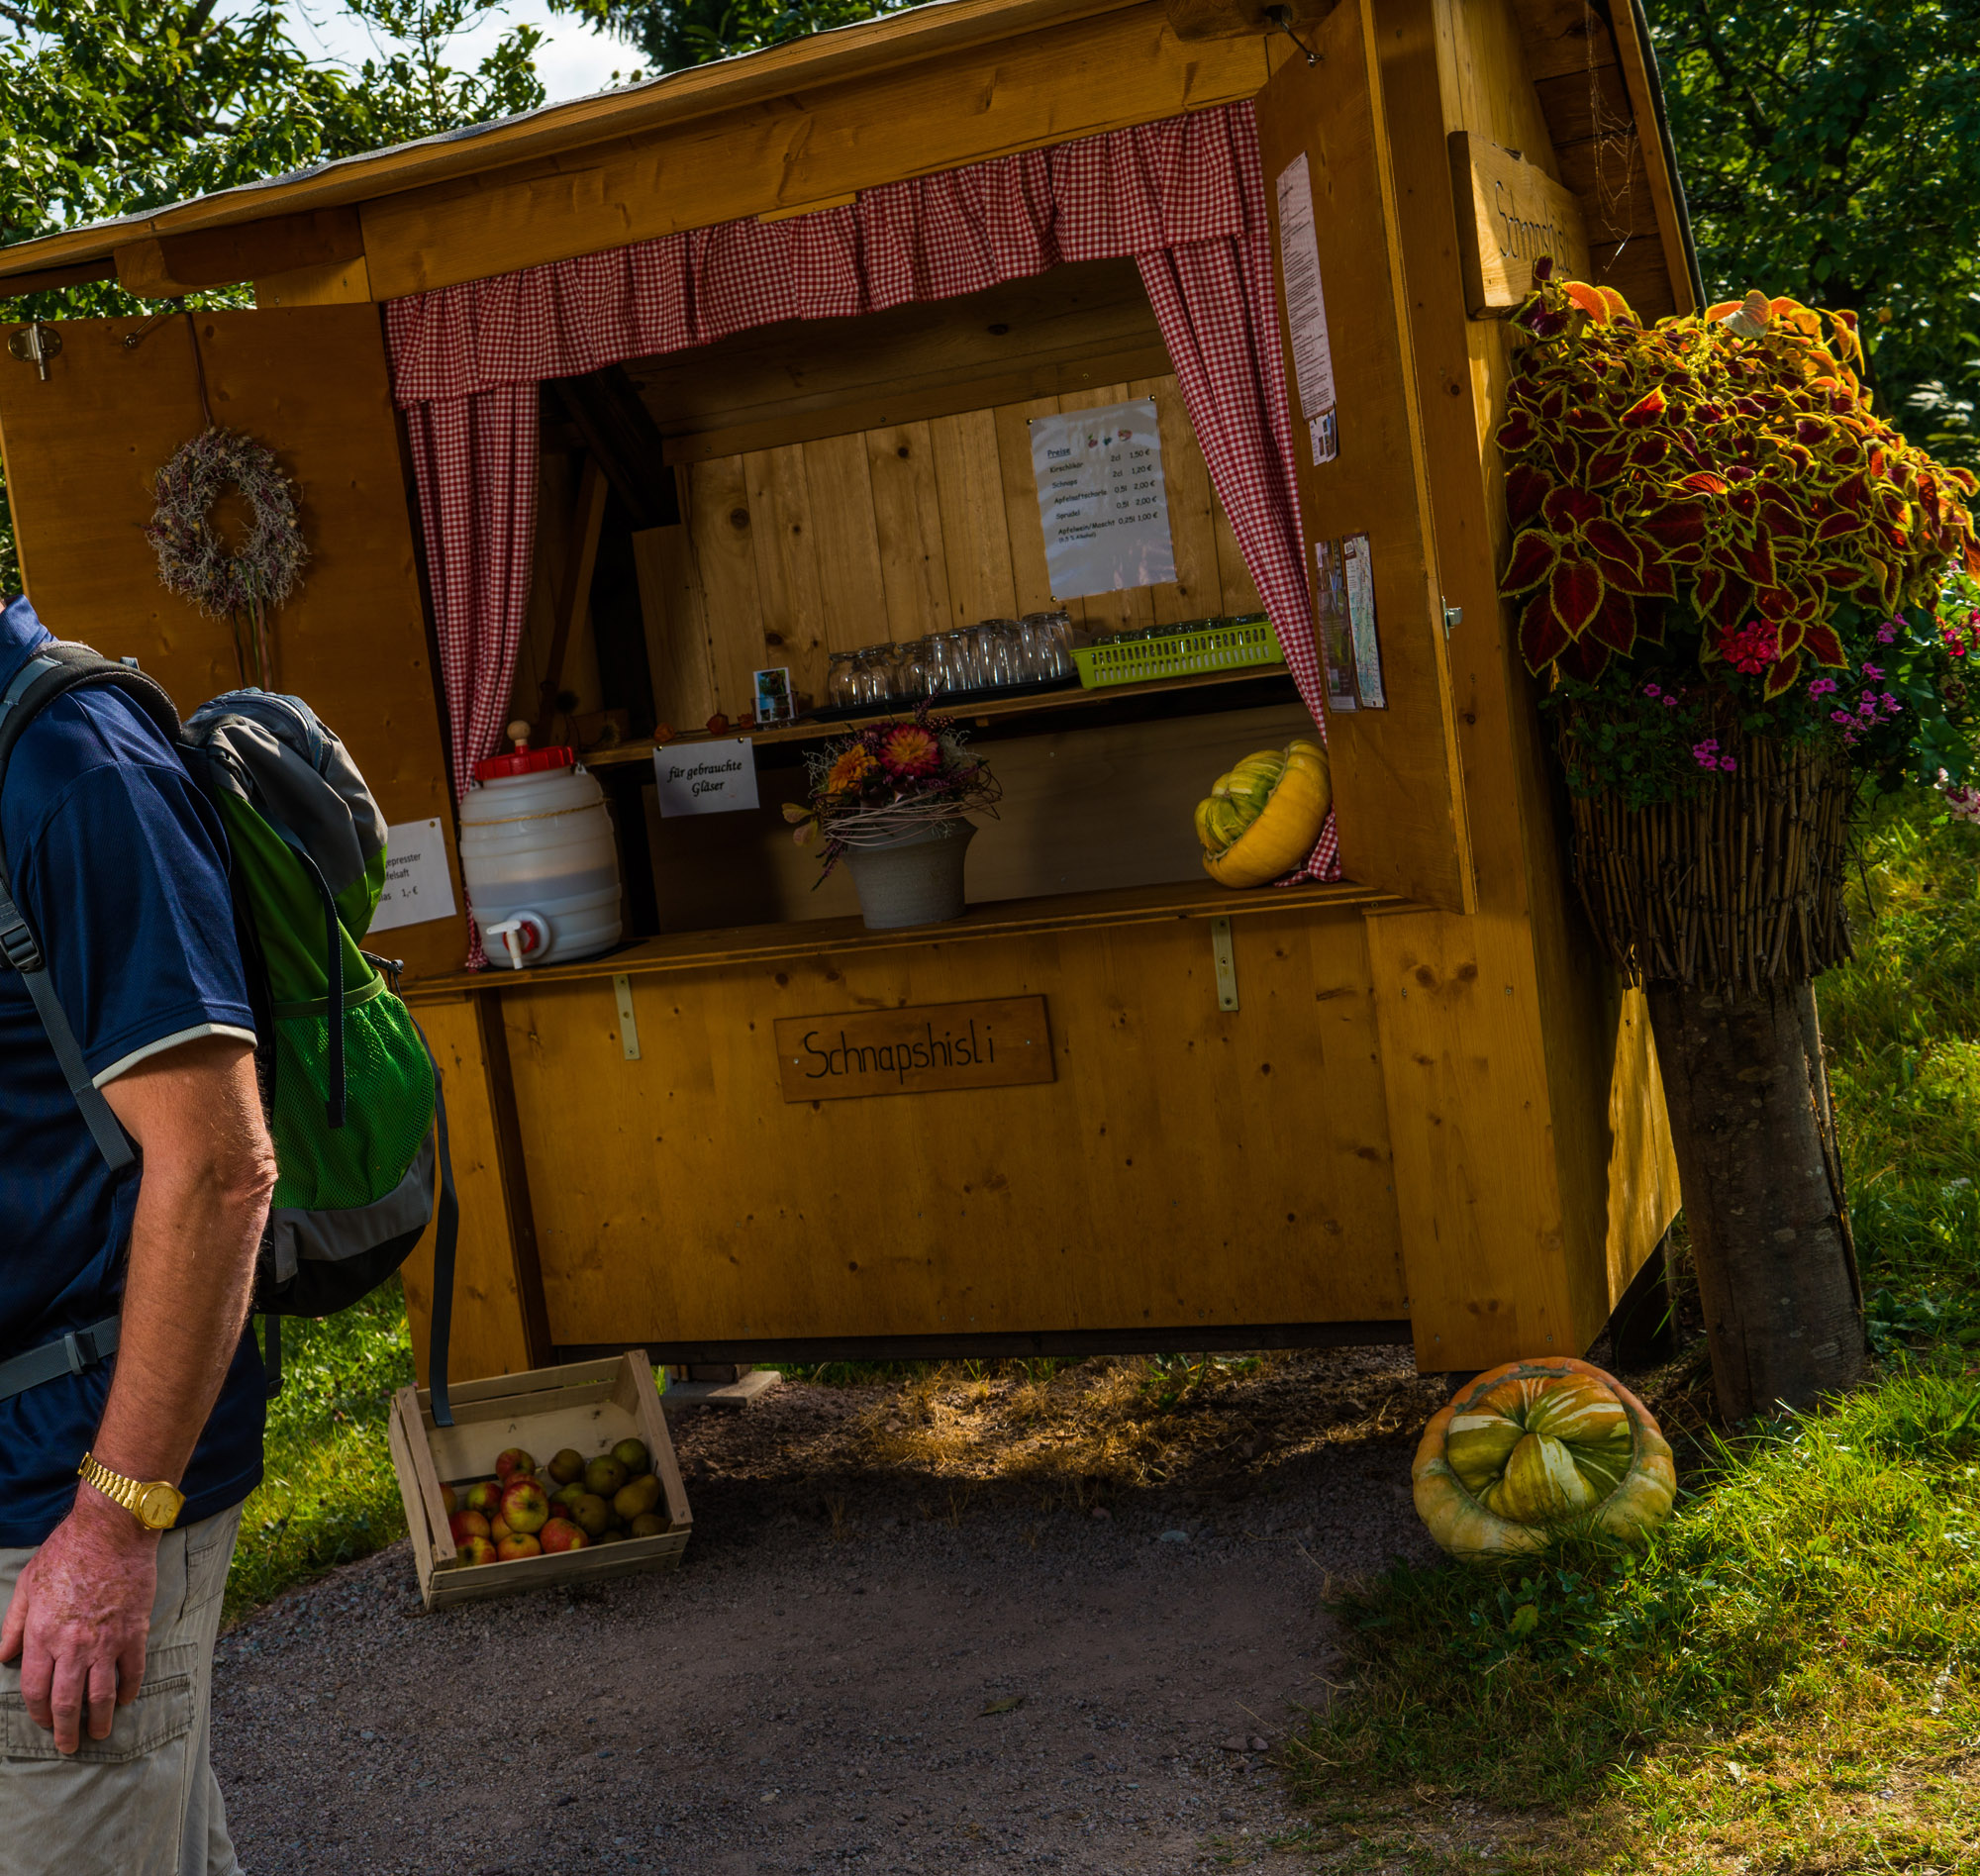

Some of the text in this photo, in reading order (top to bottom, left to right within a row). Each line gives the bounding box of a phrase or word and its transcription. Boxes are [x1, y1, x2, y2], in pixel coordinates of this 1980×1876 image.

[1047, 447, 1071, 458] Preise
[1049, 462, 1083, 473] Kirschlikör
[1130, 450, 1143, 459] 1,50
[1052, 479, 1078, 488] Schnaps
[1132, 466, 1145, 475] 1,20
[1134, 481, 1148, 490] 2,00
[1055, 510, 1080, 520] Sprudel
[1136, 497, 1150, 506] 2,00
[1138, 513, 1151, 522] 1,00
[666, 759, 742, 783] für gebrauchte
[692, 779, 725, 797] Gläser
[386, 868, 409, 880] felsaft
[804, 1019, 994, 1085] Schnapshisli
